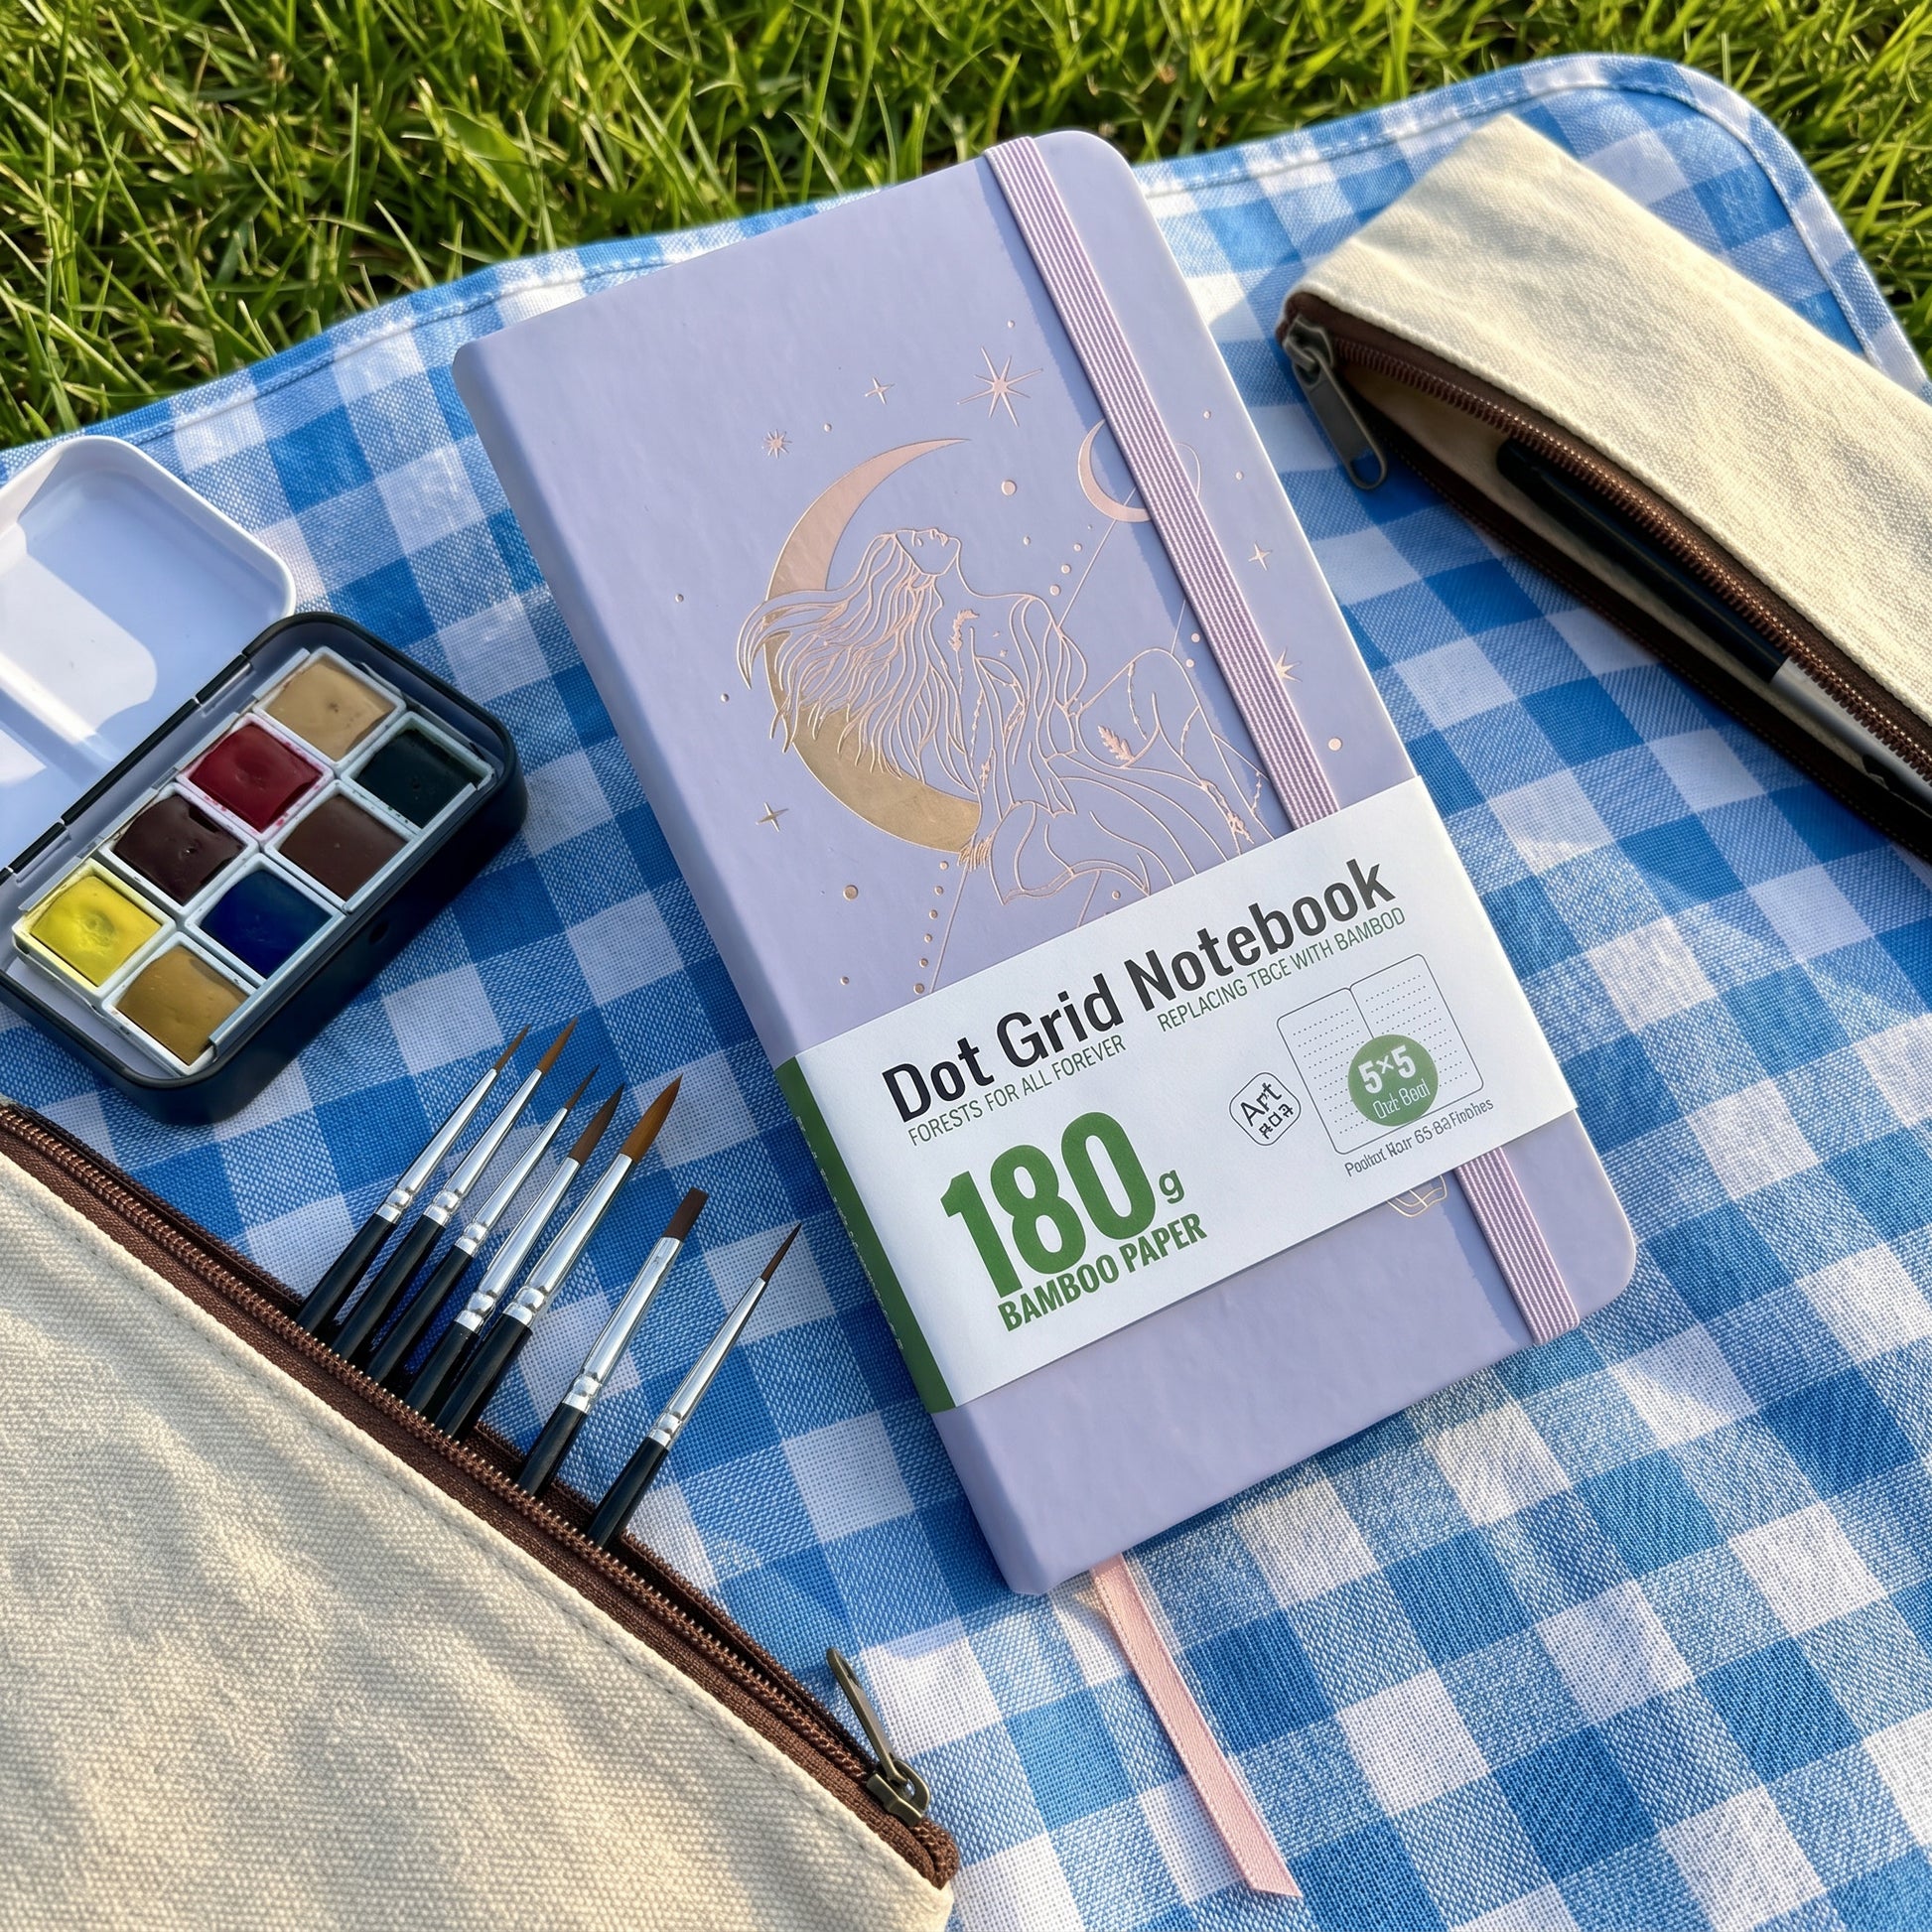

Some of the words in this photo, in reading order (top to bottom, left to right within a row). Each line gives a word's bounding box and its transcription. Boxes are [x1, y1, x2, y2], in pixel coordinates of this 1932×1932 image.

[882, 1037, 996, 1124] Dot
[996, 972, 1125, 1068] Grid
[1123, 859, 1397, 1013] Notebook
[1157, 978, 1248, 1033] REPLACING
[1290, 938, 1334, 971] WITH
[907, 1099, 984, 1147] FORESTS
[983, 1083, 1021, 1112] FOR
[1021, 1069, 1053, 1097] ALL
[1050, 1034, 1127, 1081] FOREVER
[939, 1111, 1157, 1300] 180
[1158, 1169, 1185, 1205] g
[997, 1253, 1120, 1332] BAMBOO
[1118, 1212, 1208, 1274] PAPER
